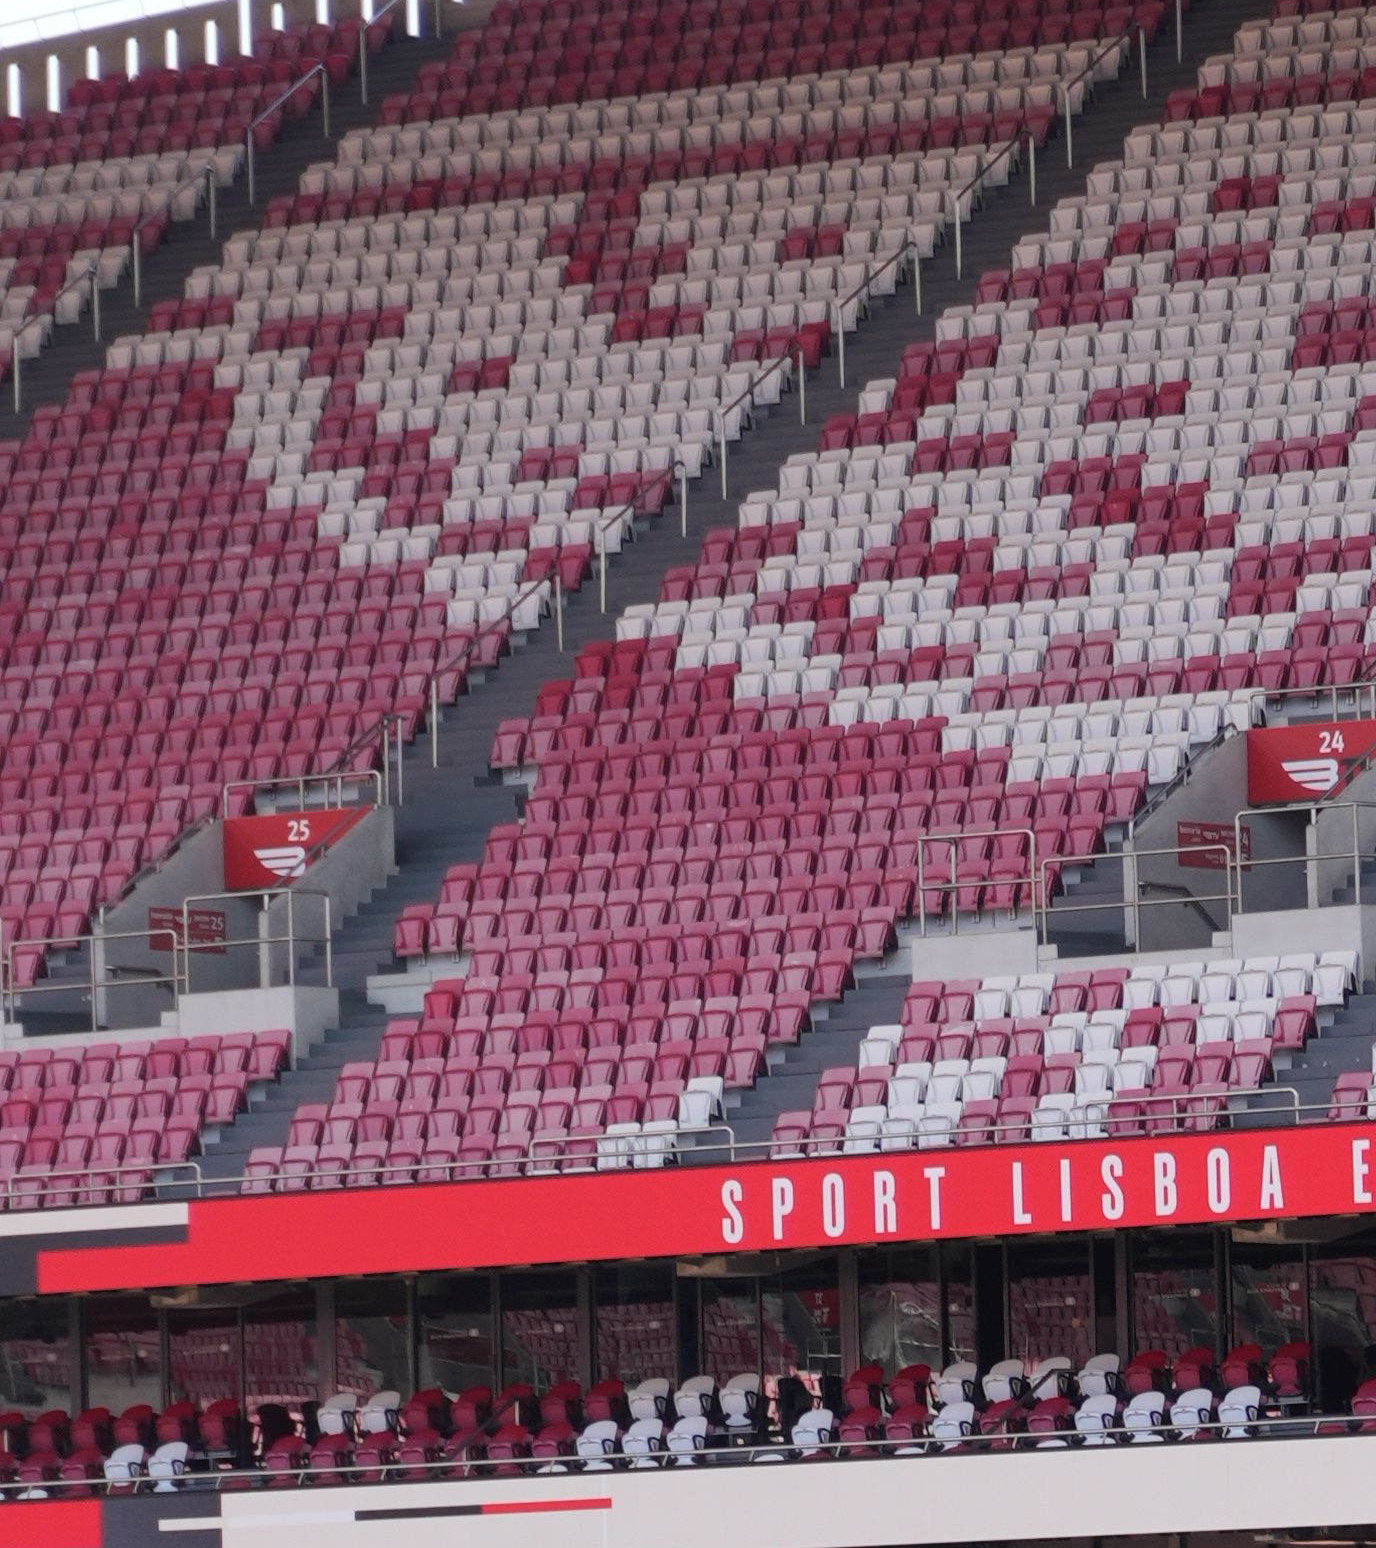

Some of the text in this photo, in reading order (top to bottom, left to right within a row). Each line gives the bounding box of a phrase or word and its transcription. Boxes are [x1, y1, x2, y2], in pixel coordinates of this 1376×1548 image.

[1318, 730, 1345, 754] 24
[287, 819, 310, 842] 25
[210, 916, 224, 930] 25
[721, 1166, 946, 1244] SPORT
[1012, 1144, 1284, 1225] LISBOA
[1351, 1138, 1373, 1204] E
